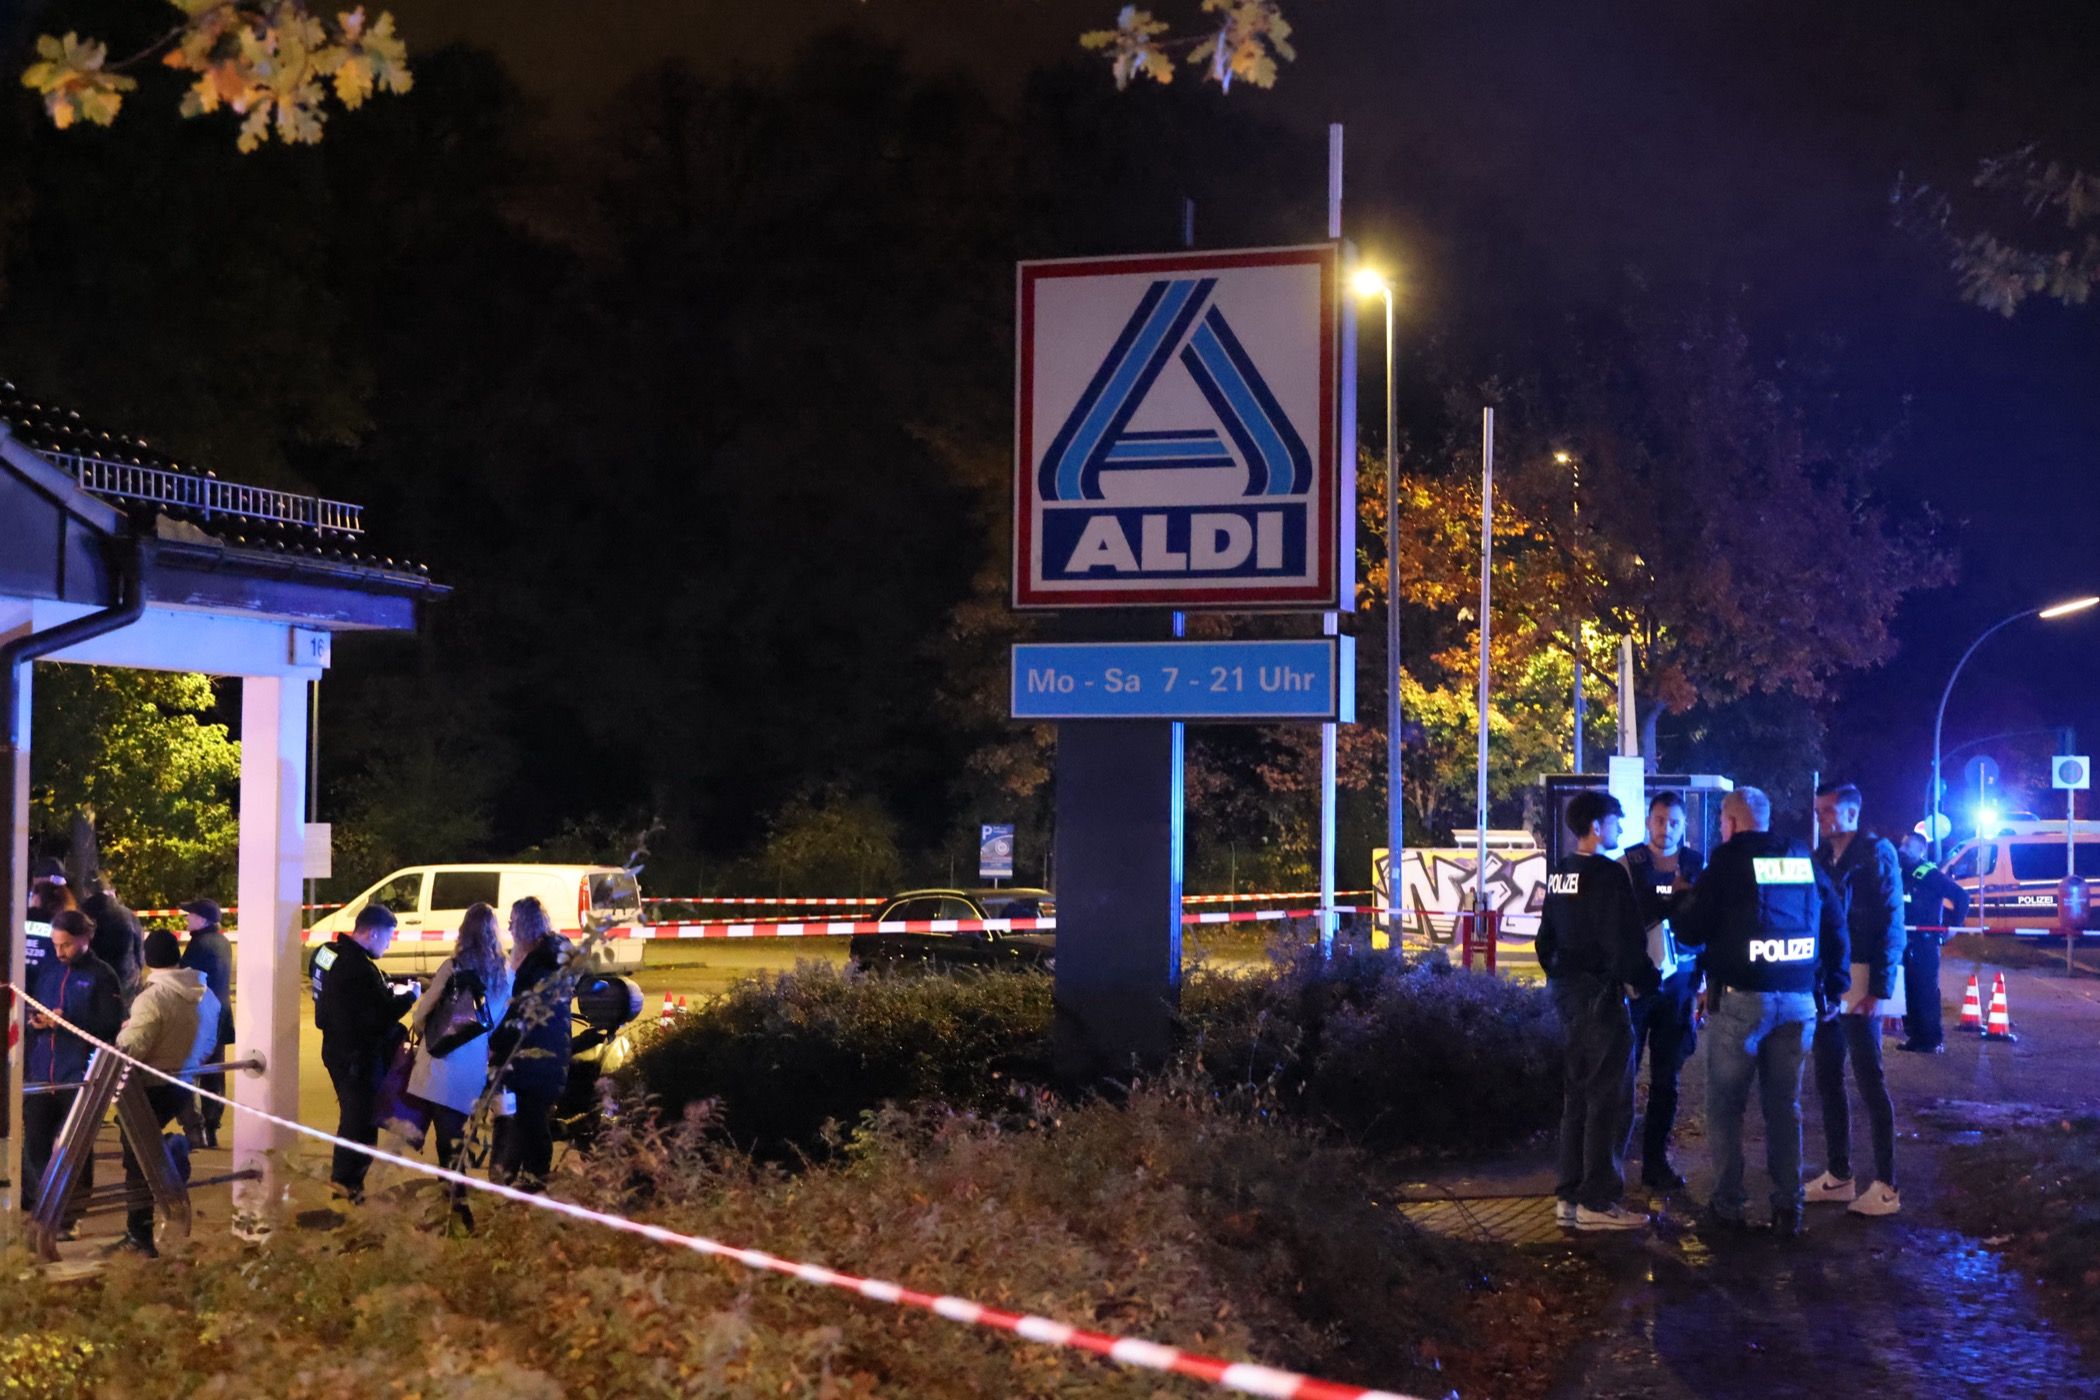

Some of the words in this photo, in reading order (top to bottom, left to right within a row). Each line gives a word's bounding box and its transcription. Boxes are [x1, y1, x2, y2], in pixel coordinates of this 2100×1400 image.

[1064, 511, 1284, 572] ALDI
[1027, 668, 1075, 693] Mo
[1104, 667, 1142, 693] Sa
[1162, 667, 1179, 692] 7
[1209, 666, 1244, 692] 21
[1258, 666, 1316, 692] Uhr
[982, 825, 993, 840] P
[1754, 859, 1813, 880] POLIZEI
[1547, 873, 1579, 894] POLIZEI
[2018, 896, 2054, 904] POLIZEI
[1749, 937, 1815, 962] POLIZEI
